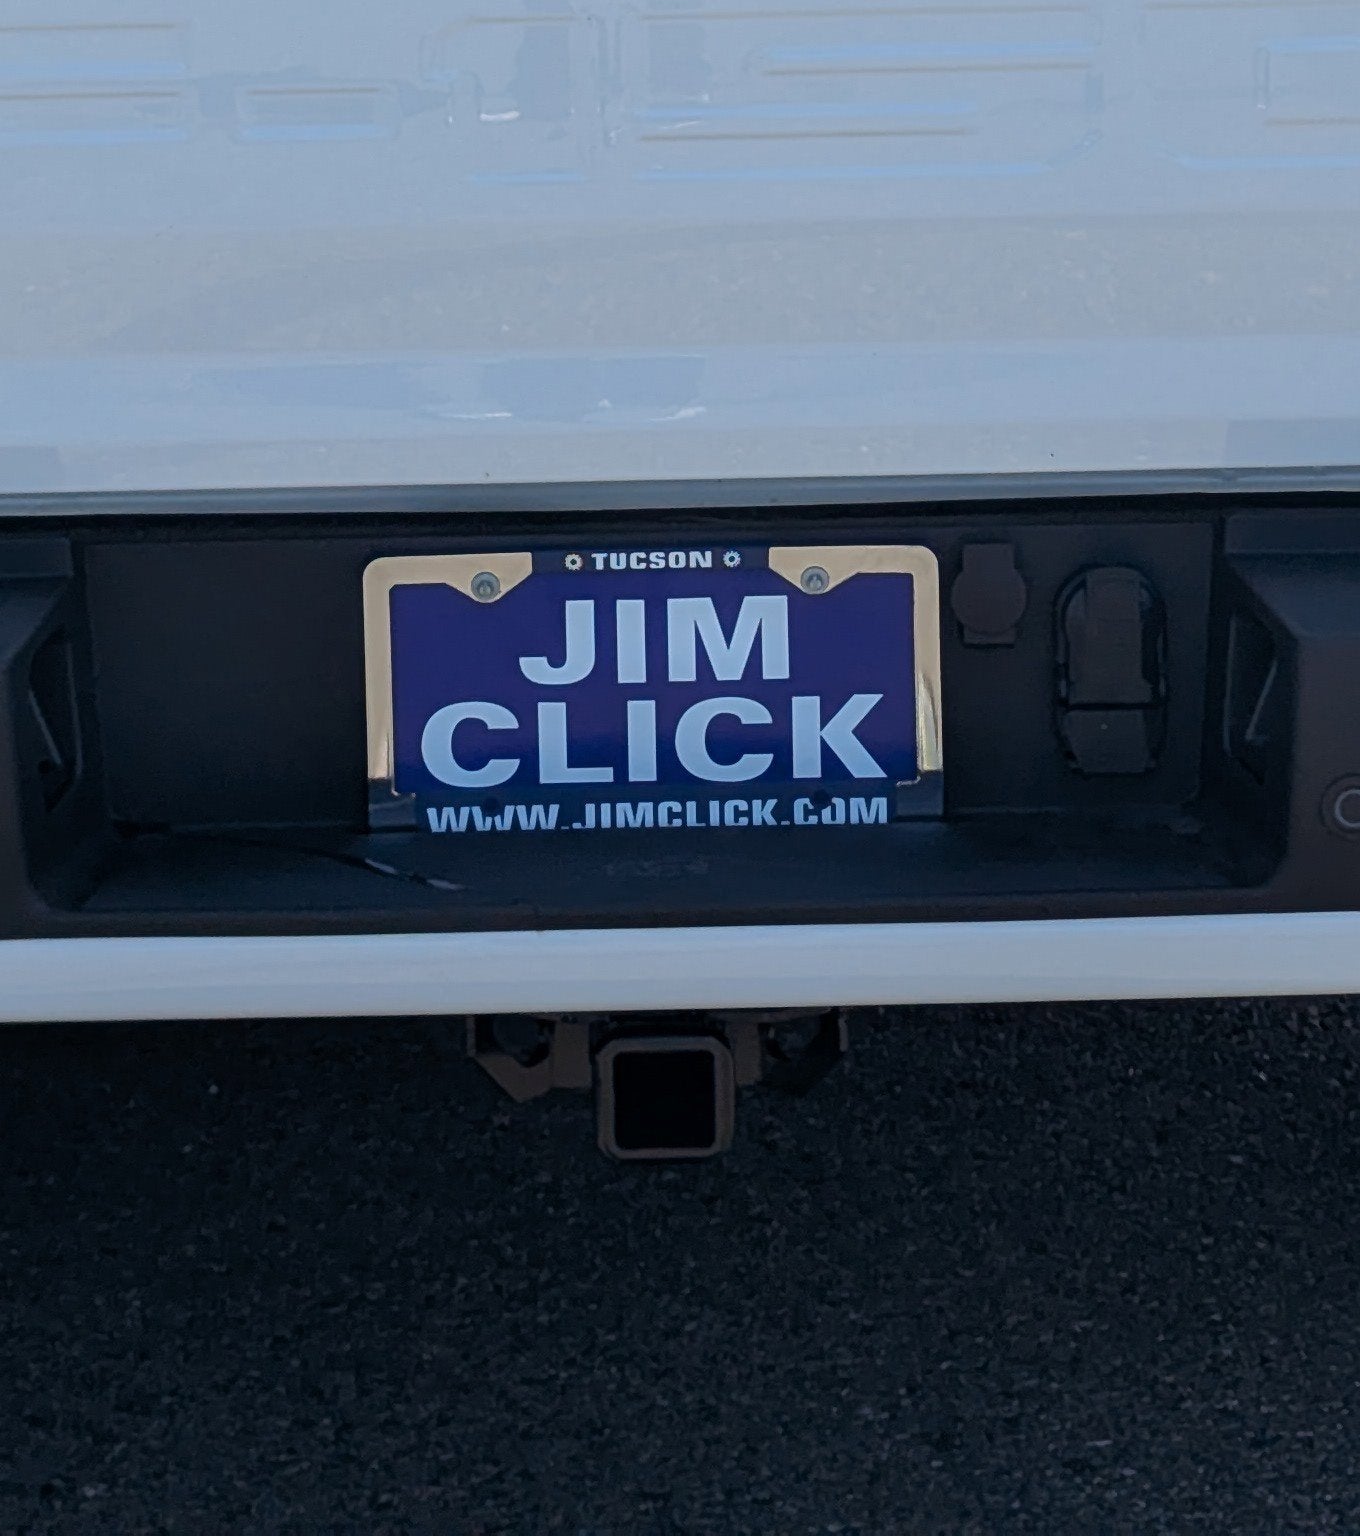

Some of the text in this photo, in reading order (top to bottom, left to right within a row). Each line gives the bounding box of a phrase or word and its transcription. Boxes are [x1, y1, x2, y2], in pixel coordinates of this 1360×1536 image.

[591, 550, 713, 571] TUCSON
[519, 595, 790, 685] JIM
[421, 694, 888, 788] CLICK
[426, 797, 888, 833] WWW.JIMCLICK.COM
